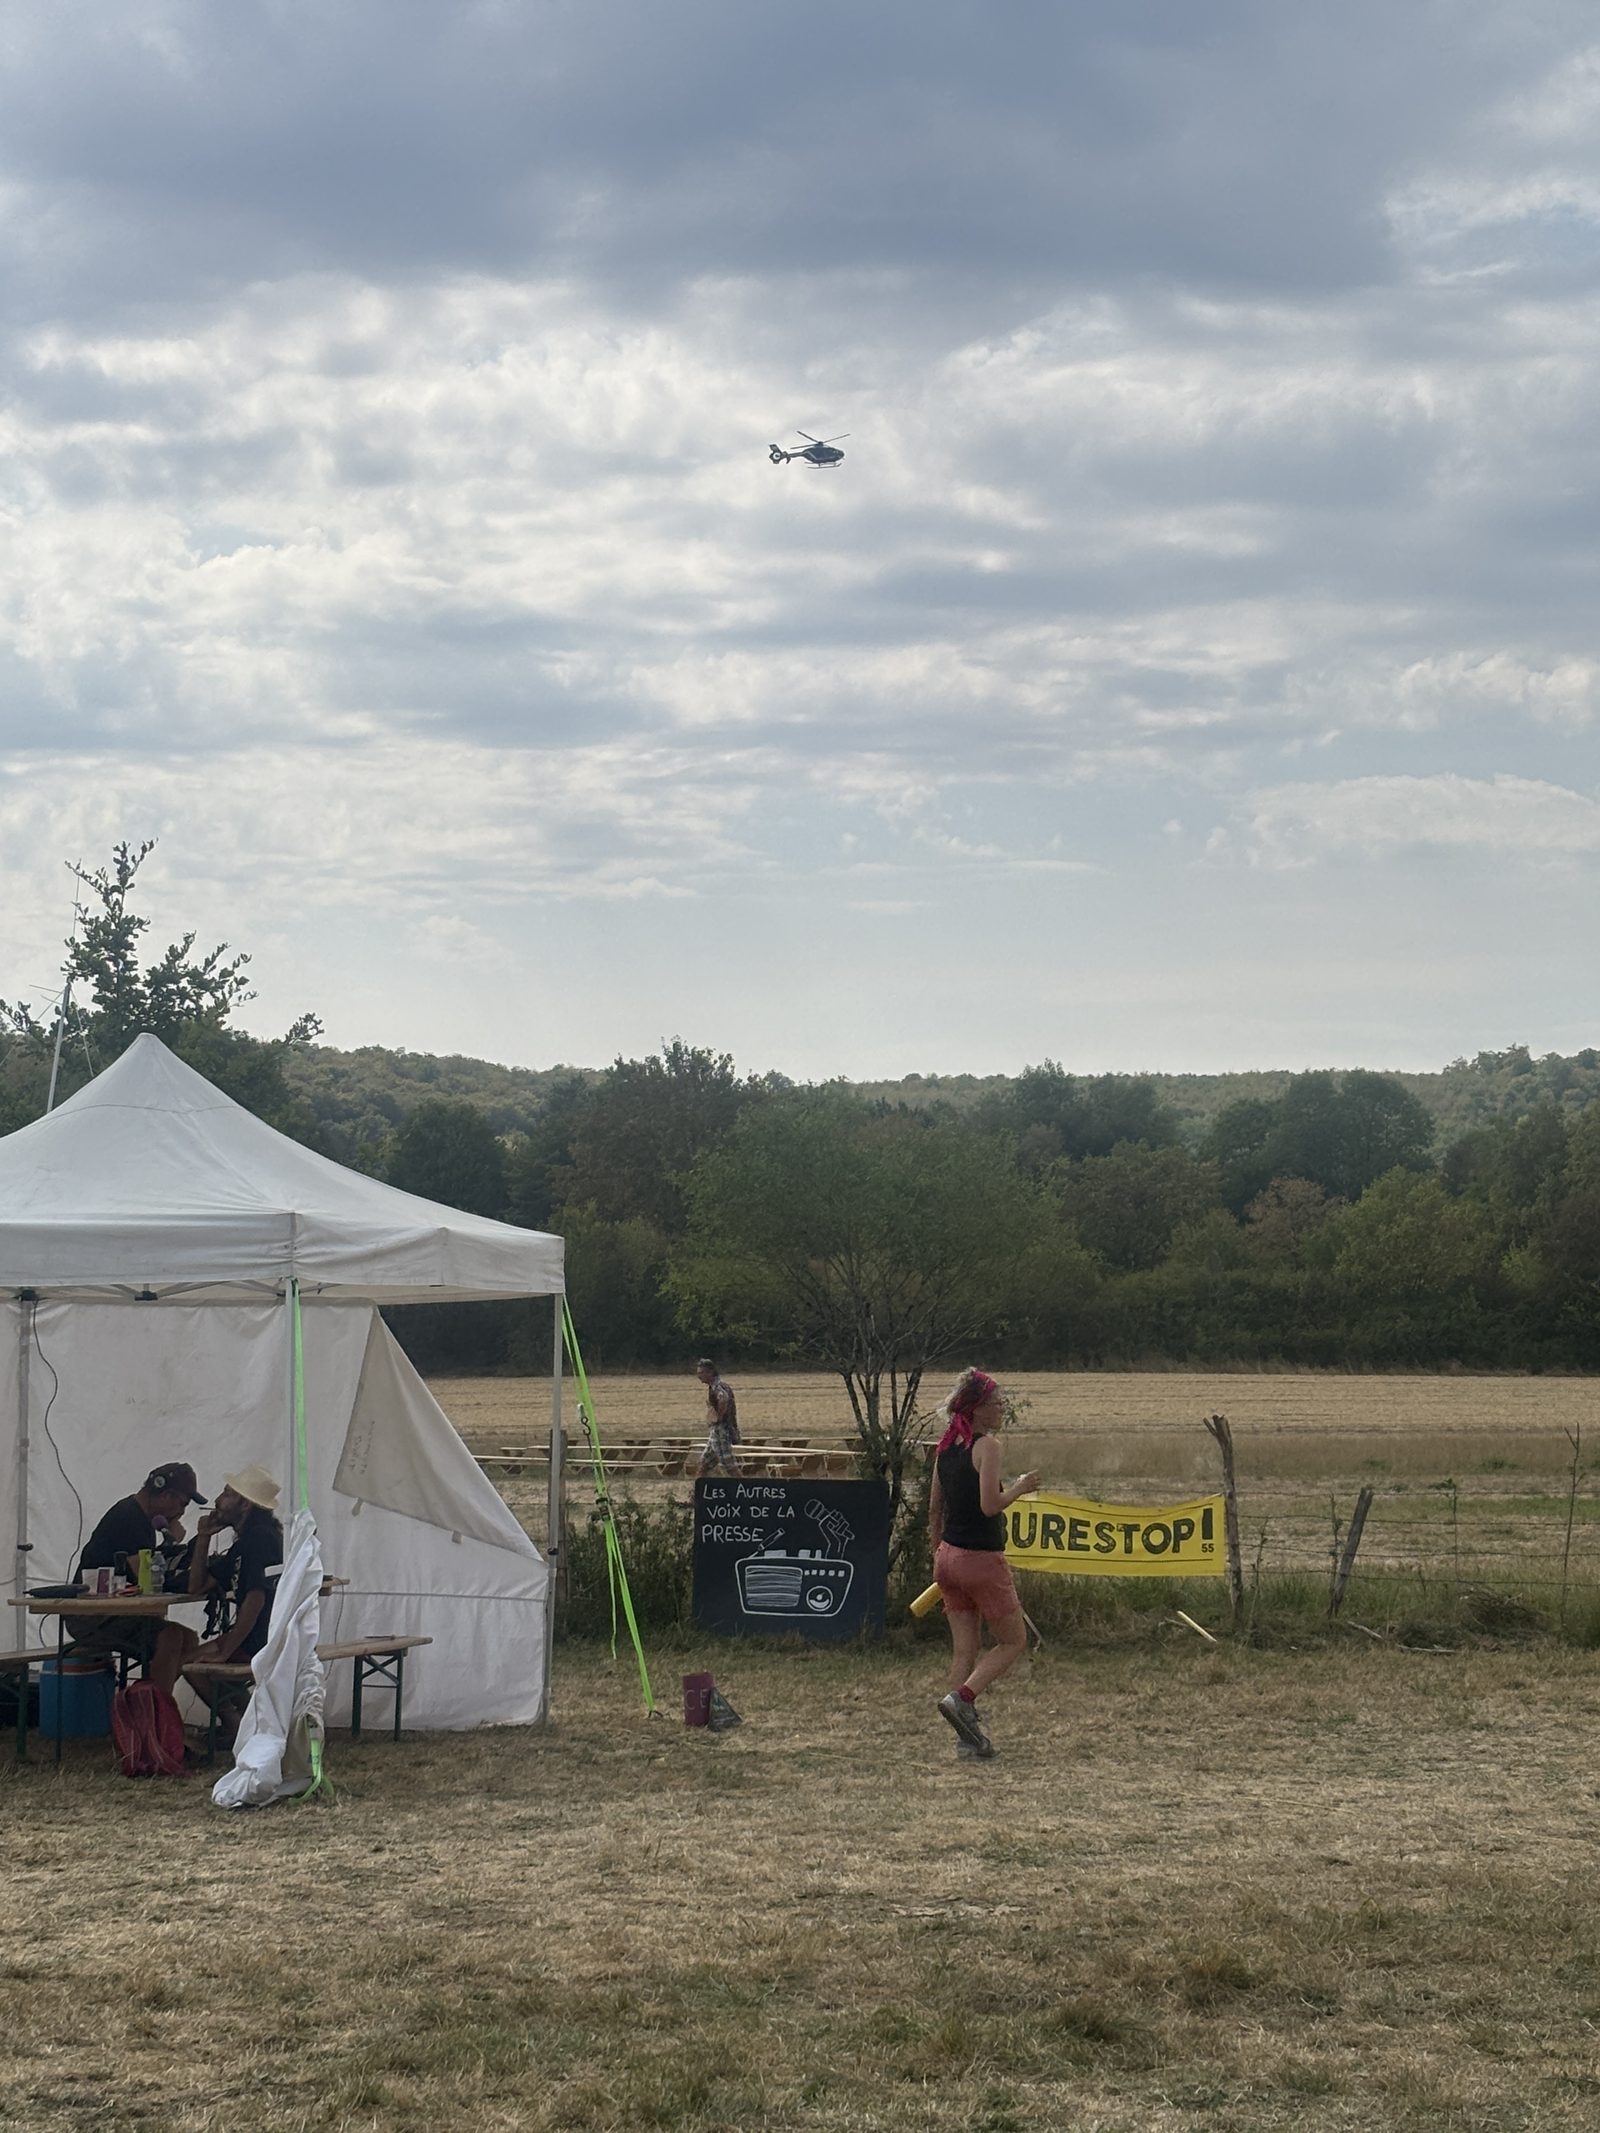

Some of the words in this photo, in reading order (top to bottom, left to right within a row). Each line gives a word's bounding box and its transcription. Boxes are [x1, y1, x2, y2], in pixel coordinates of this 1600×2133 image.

[750, 1506, 770, 1518] DE
[777, 1505, 795, 1518] LA
[702, 1524, 764, 1543] PRESSE
[1002, 1507, 1213, 1554] URESTOP!
[1201, 1543, 1215, 1553] 55
